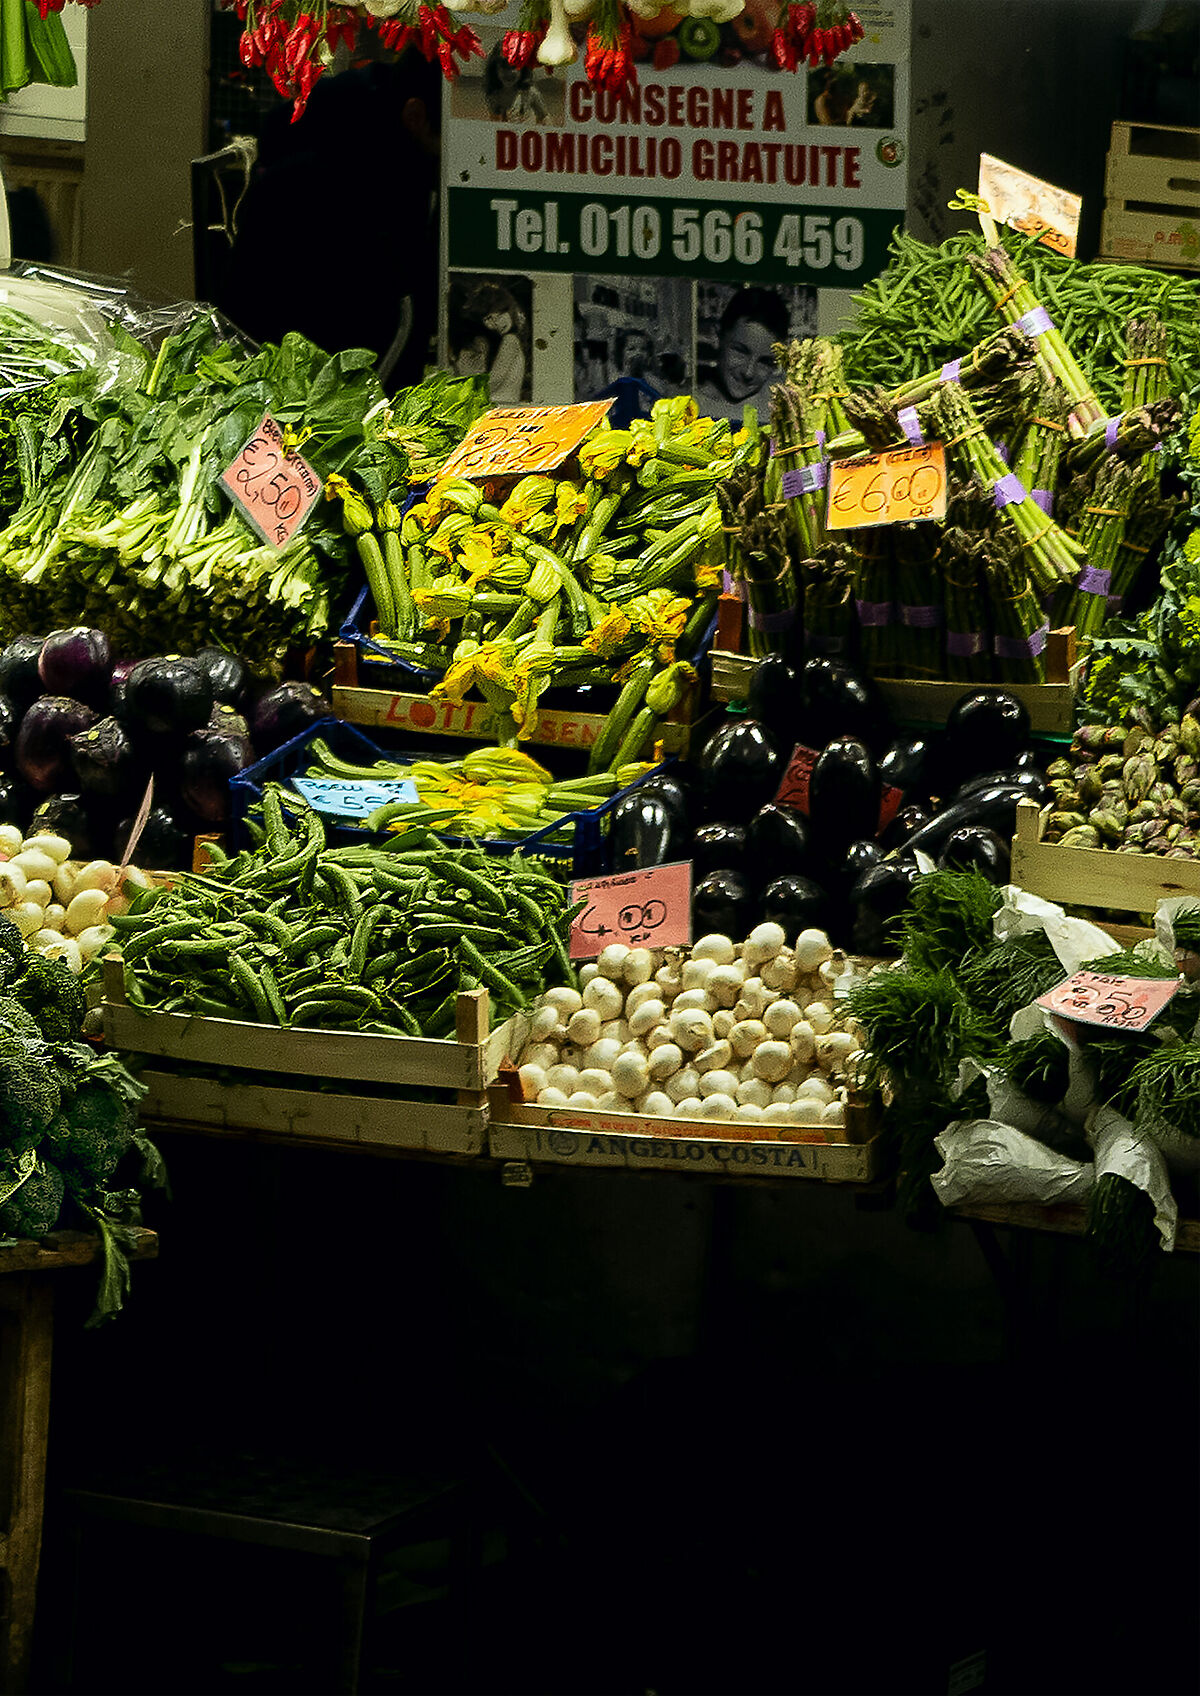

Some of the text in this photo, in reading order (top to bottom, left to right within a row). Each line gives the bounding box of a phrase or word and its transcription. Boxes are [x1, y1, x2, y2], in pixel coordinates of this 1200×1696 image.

[569, 80, 786, 132] CONSEGNE A
[495, 130, 861, 188] DOMICILIO GRATUITE
[490, 199, 864, 270] Tel. 010 566 459
[587, 1140, 806, 1168] ANGELO COSTA
